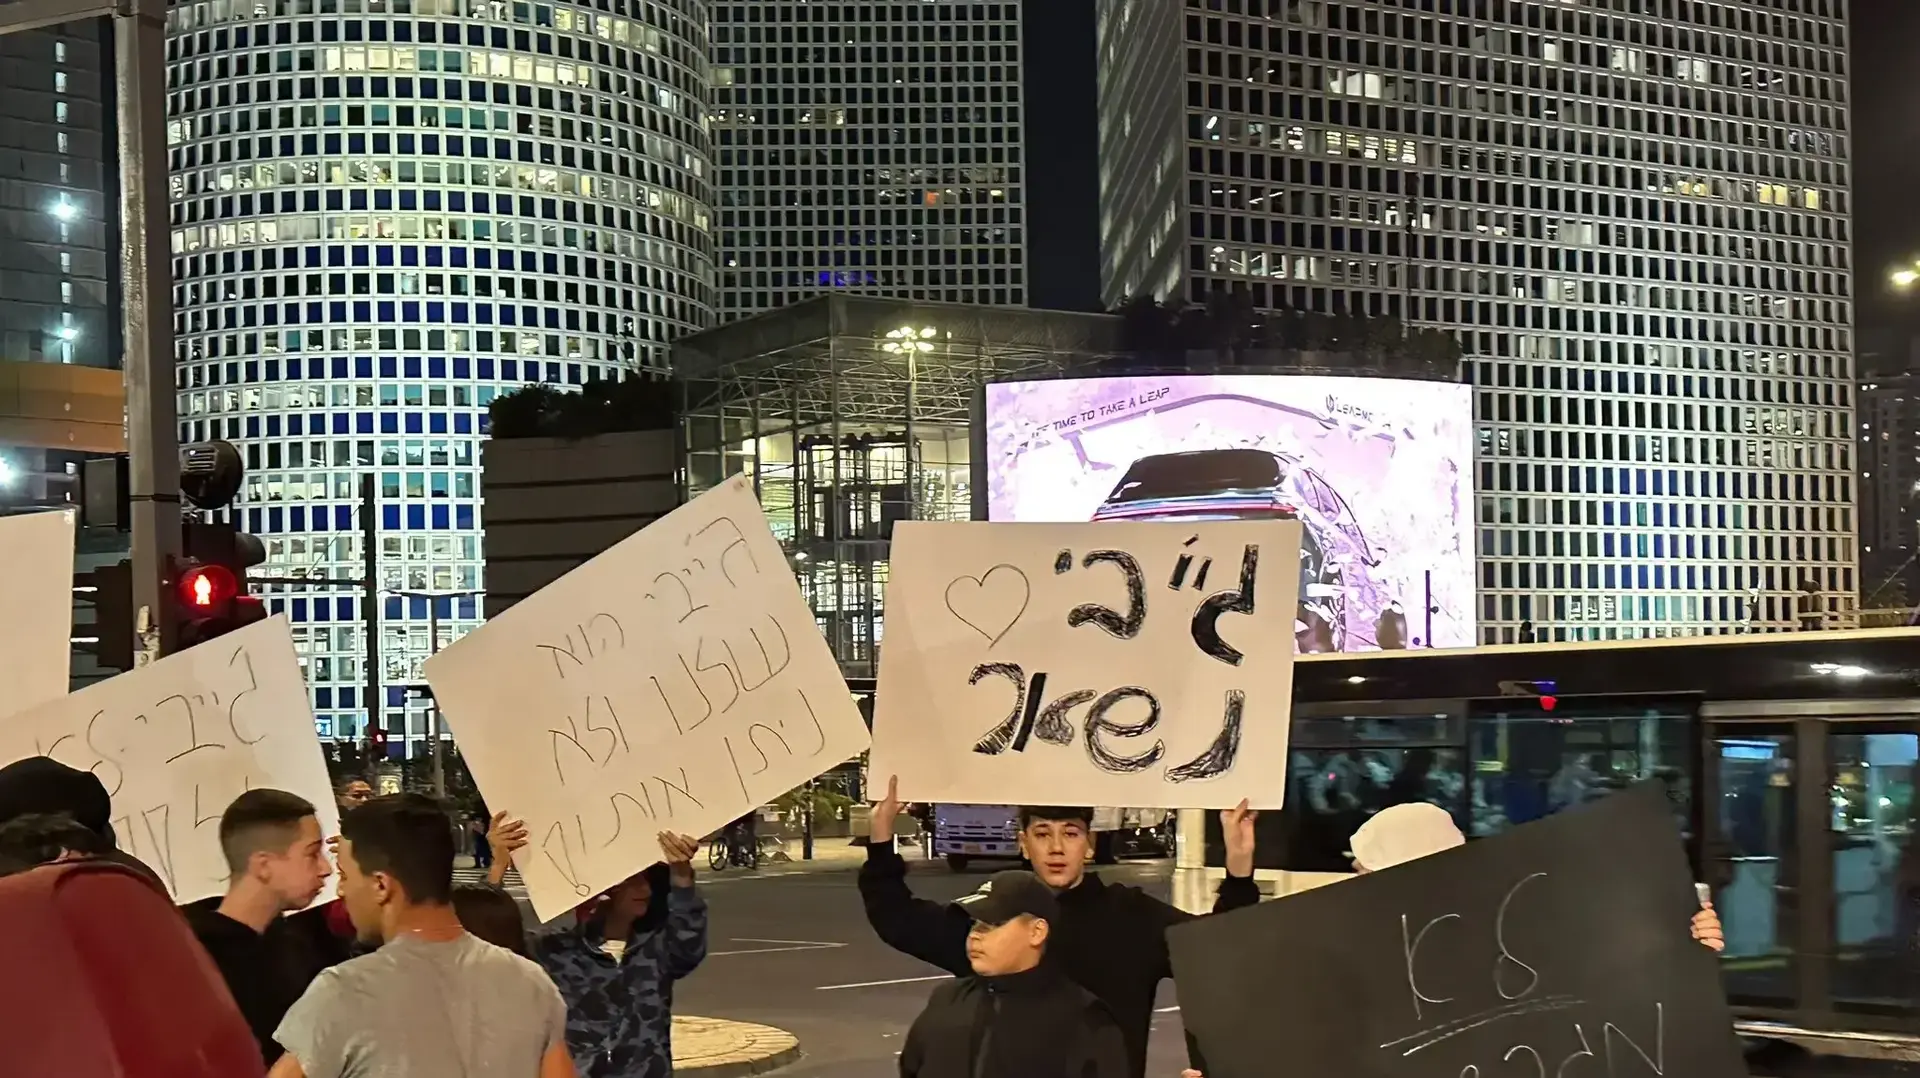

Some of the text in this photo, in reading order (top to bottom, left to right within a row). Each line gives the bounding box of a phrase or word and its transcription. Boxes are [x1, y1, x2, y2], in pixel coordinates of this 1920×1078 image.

[1053, 387, 1170, 430] TIME TO TAKE A LEAP
[548, 695, 630, 787] ולא
[968, 660, 1246, 784] נשאר
[1401, 871, 1548, 1020] לא
